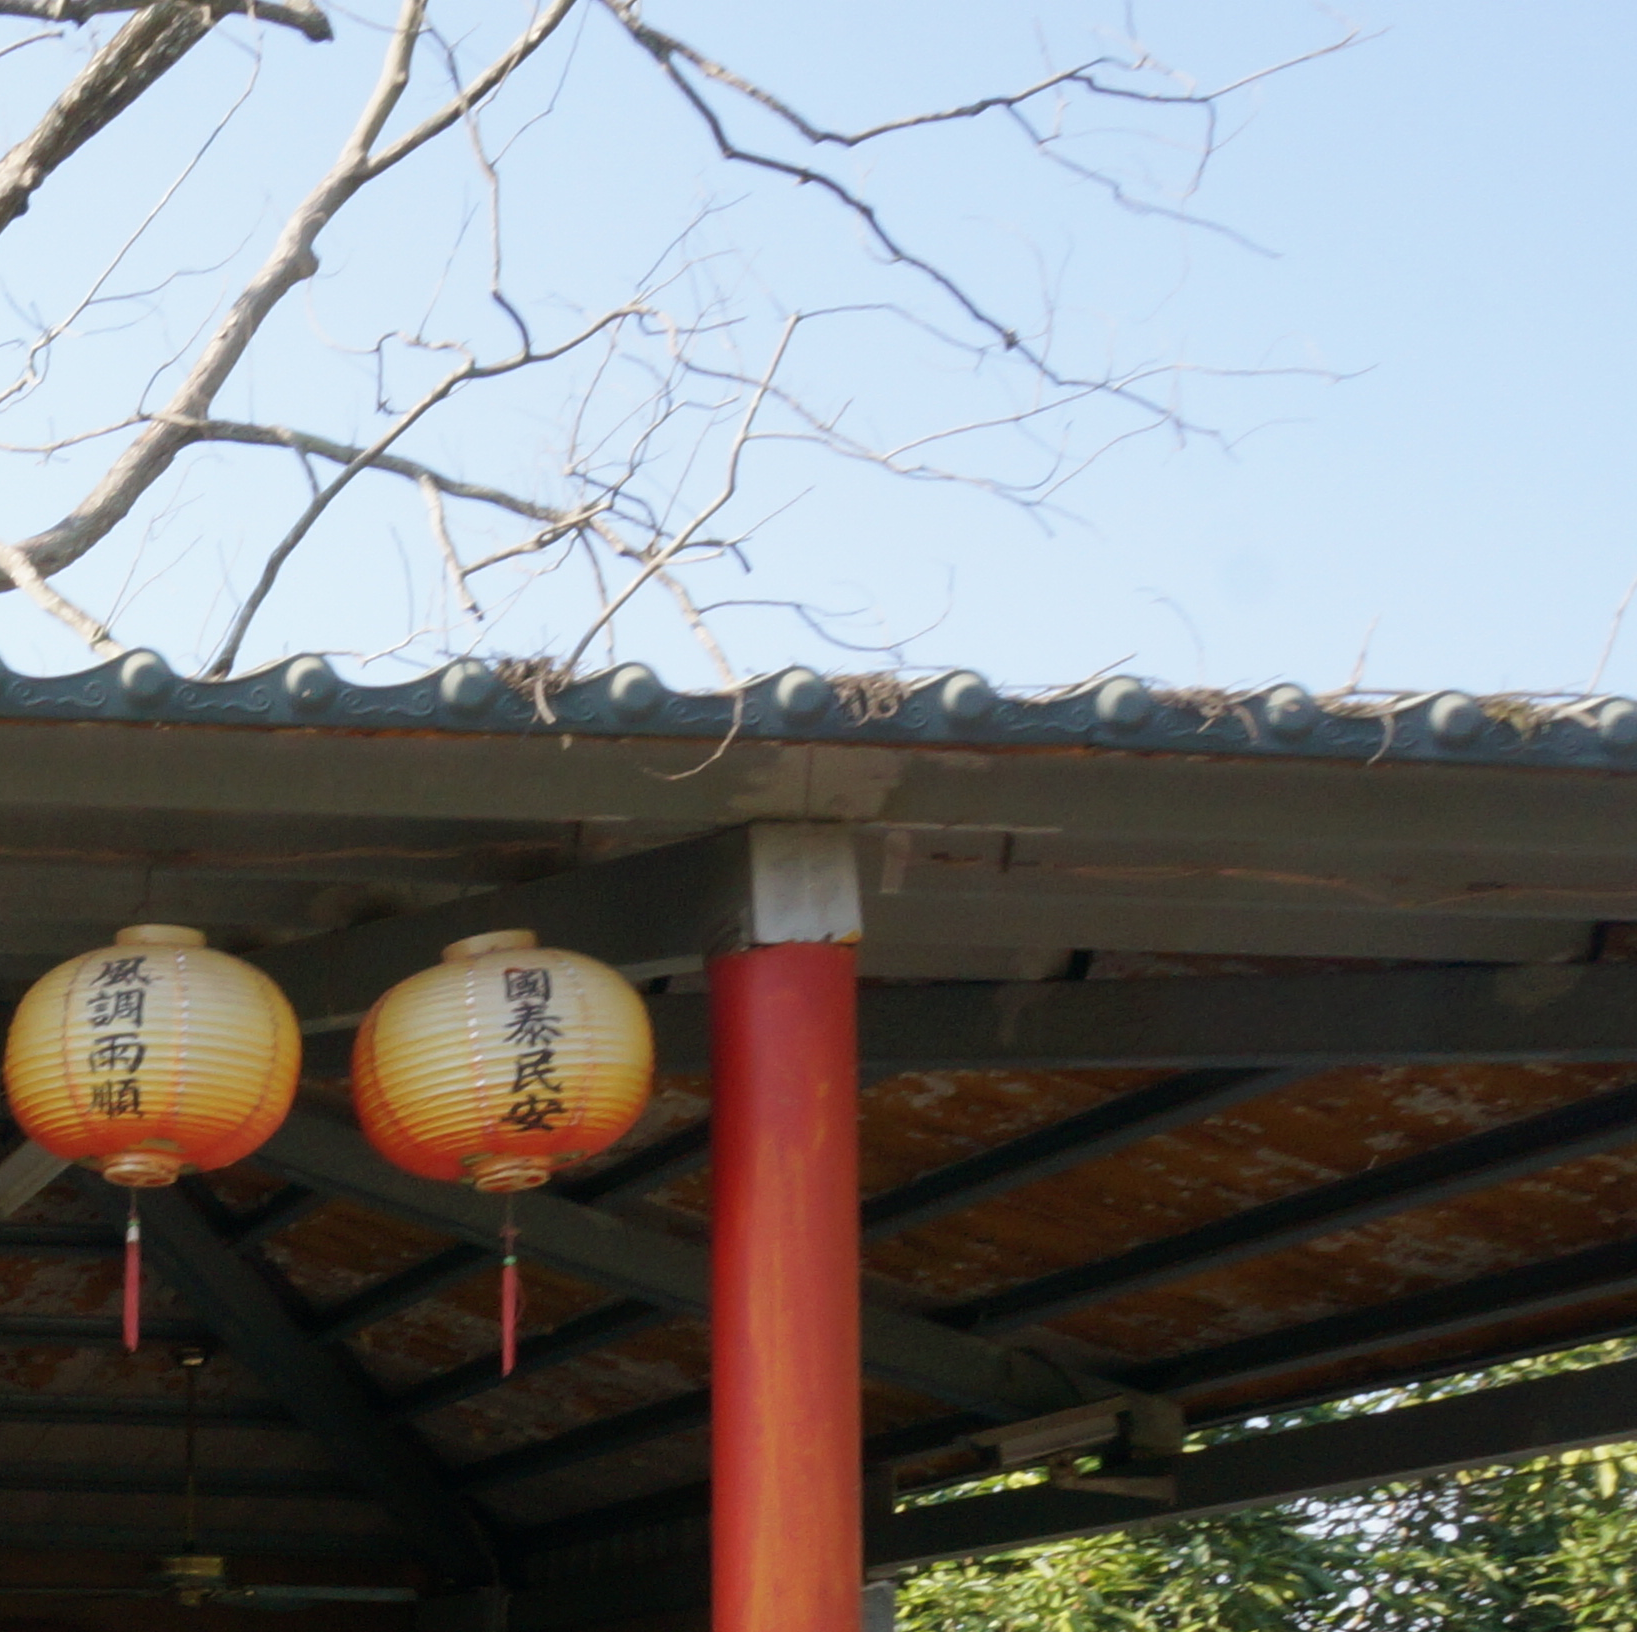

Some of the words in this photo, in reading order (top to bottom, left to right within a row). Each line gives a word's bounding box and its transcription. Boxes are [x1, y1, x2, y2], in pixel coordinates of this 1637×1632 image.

[87, 955, 147, 1121] 風調雨順
[500, 966, 567, 1132] 國泰民安
